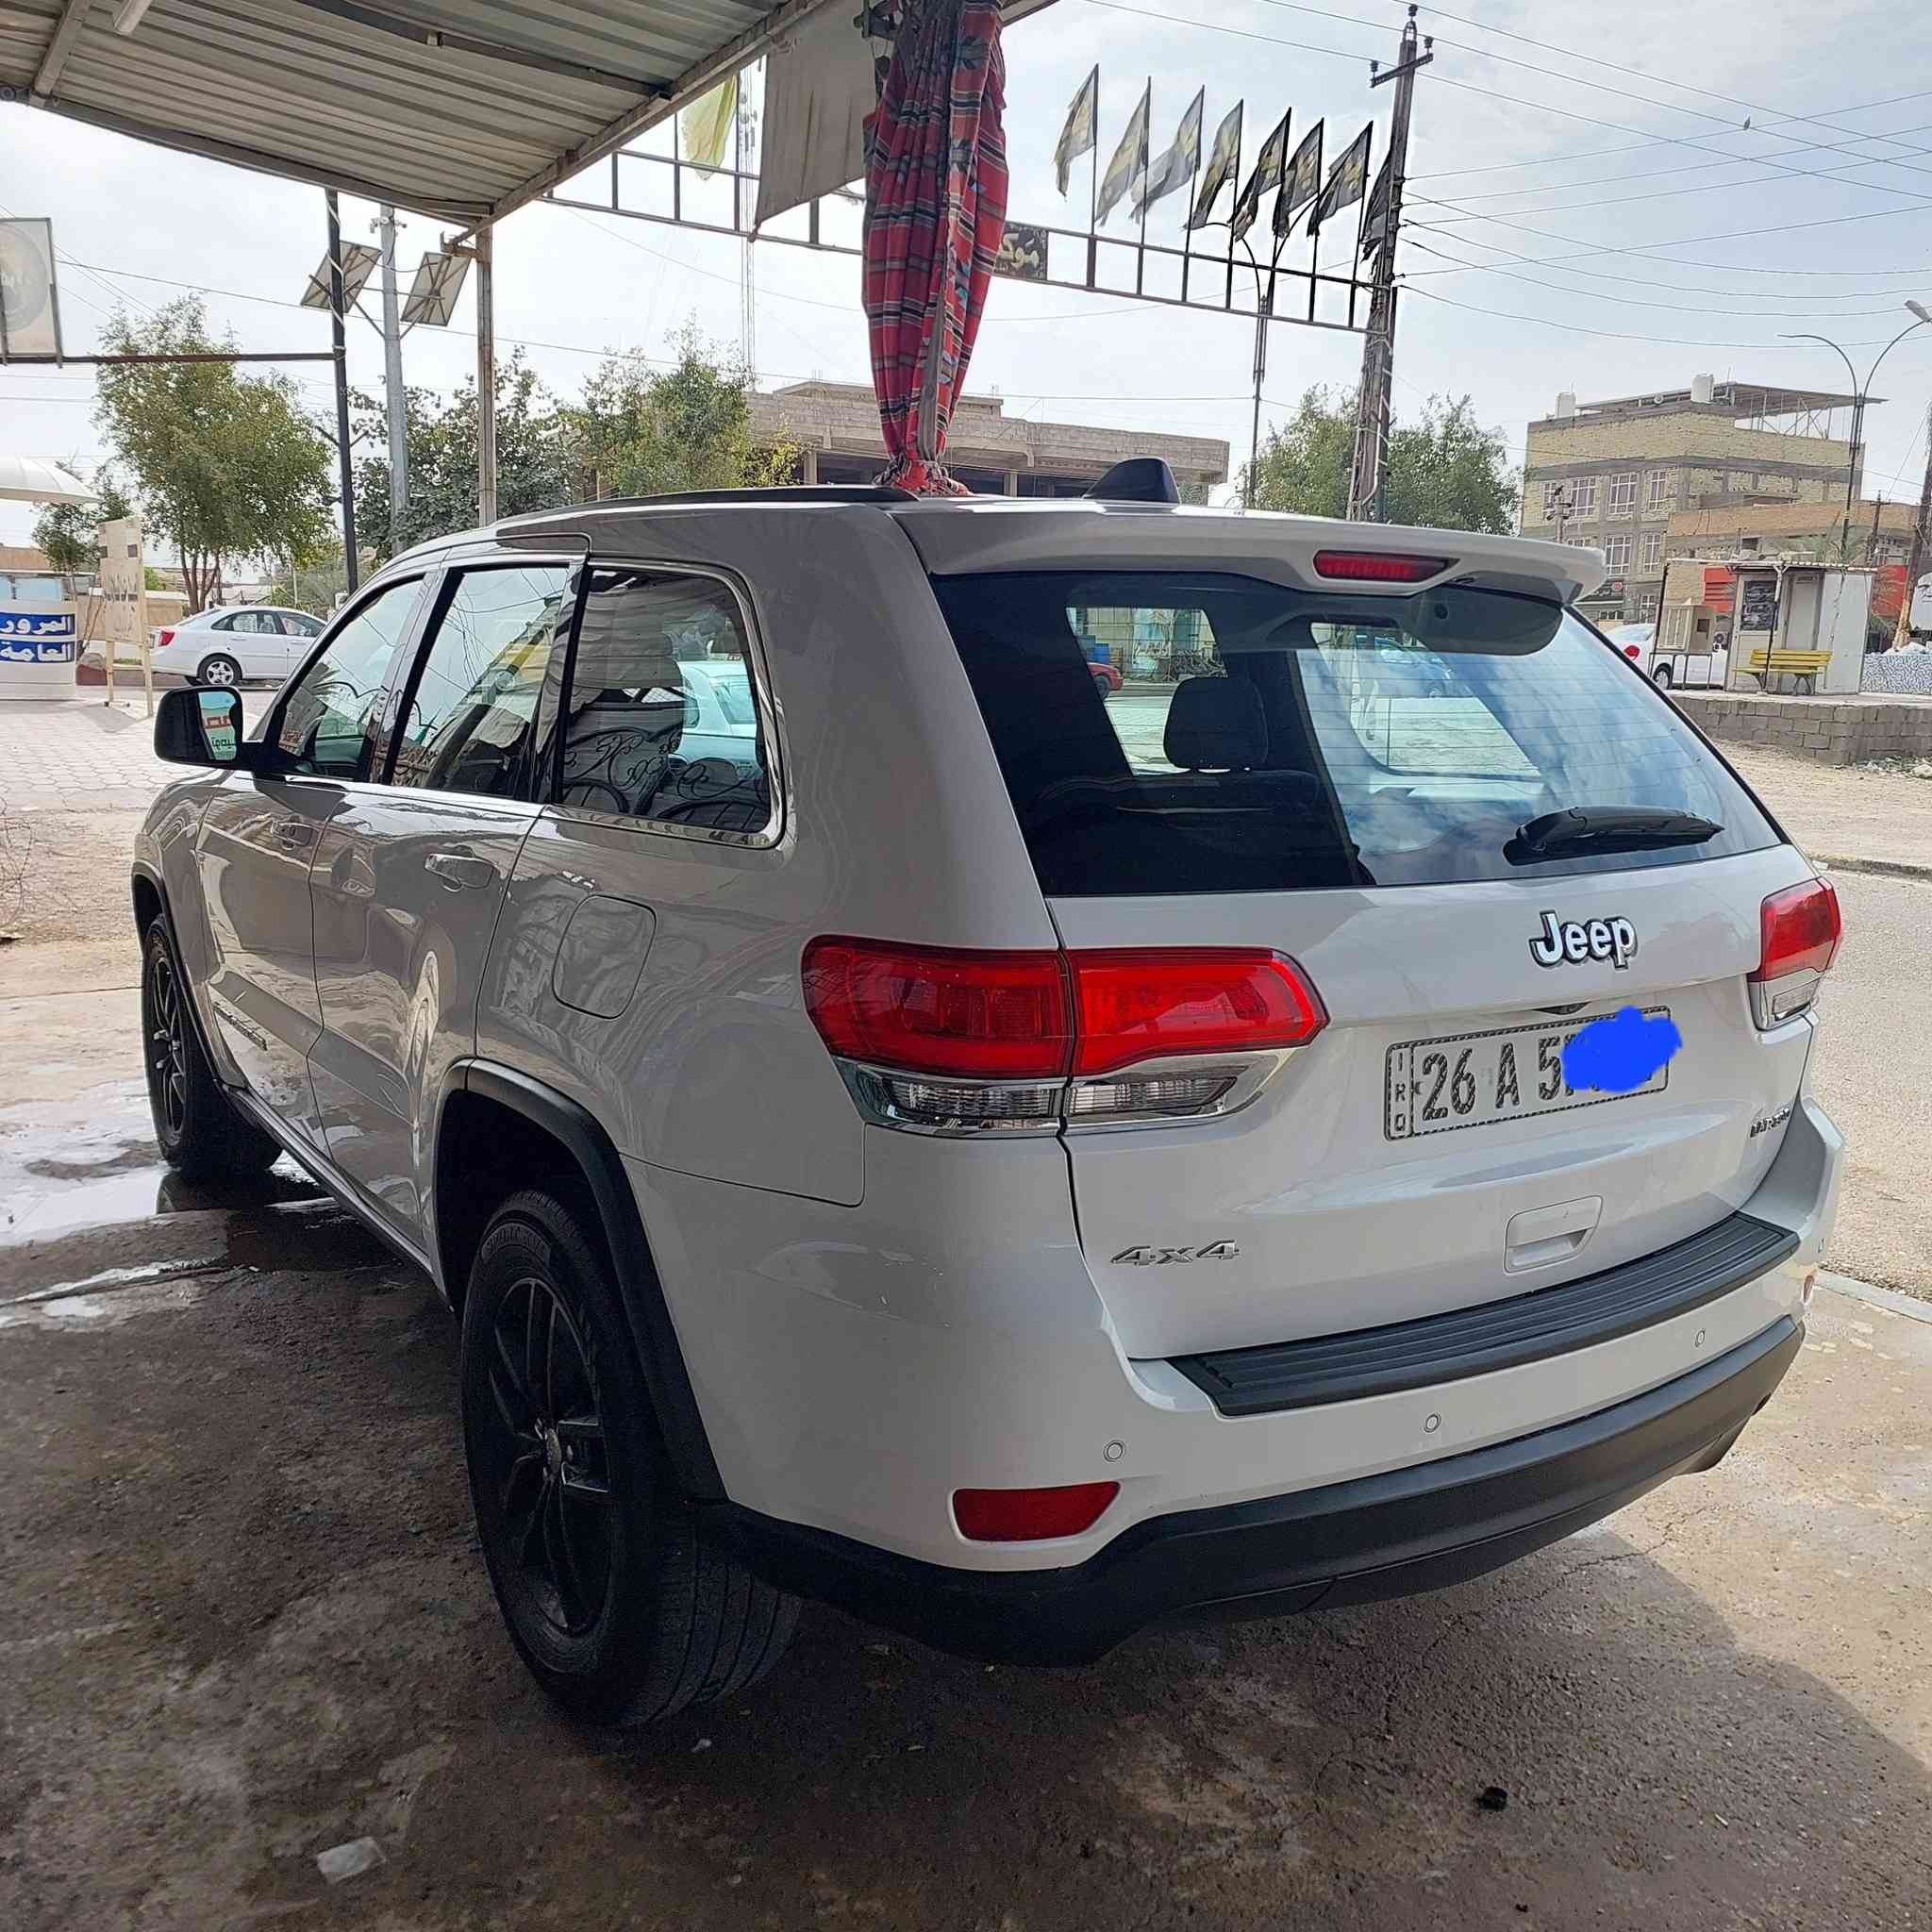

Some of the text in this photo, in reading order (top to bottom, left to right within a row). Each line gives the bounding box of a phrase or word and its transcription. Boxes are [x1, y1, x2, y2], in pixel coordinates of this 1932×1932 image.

[0, 616, 72, 635] المرور
[0, 641, 72, 662] العامة
[1529, 909, 1638, 971] Jeep
[1422, 1048, 1475, 1121] 26
[1495, 1041, 1521, 1109] A
